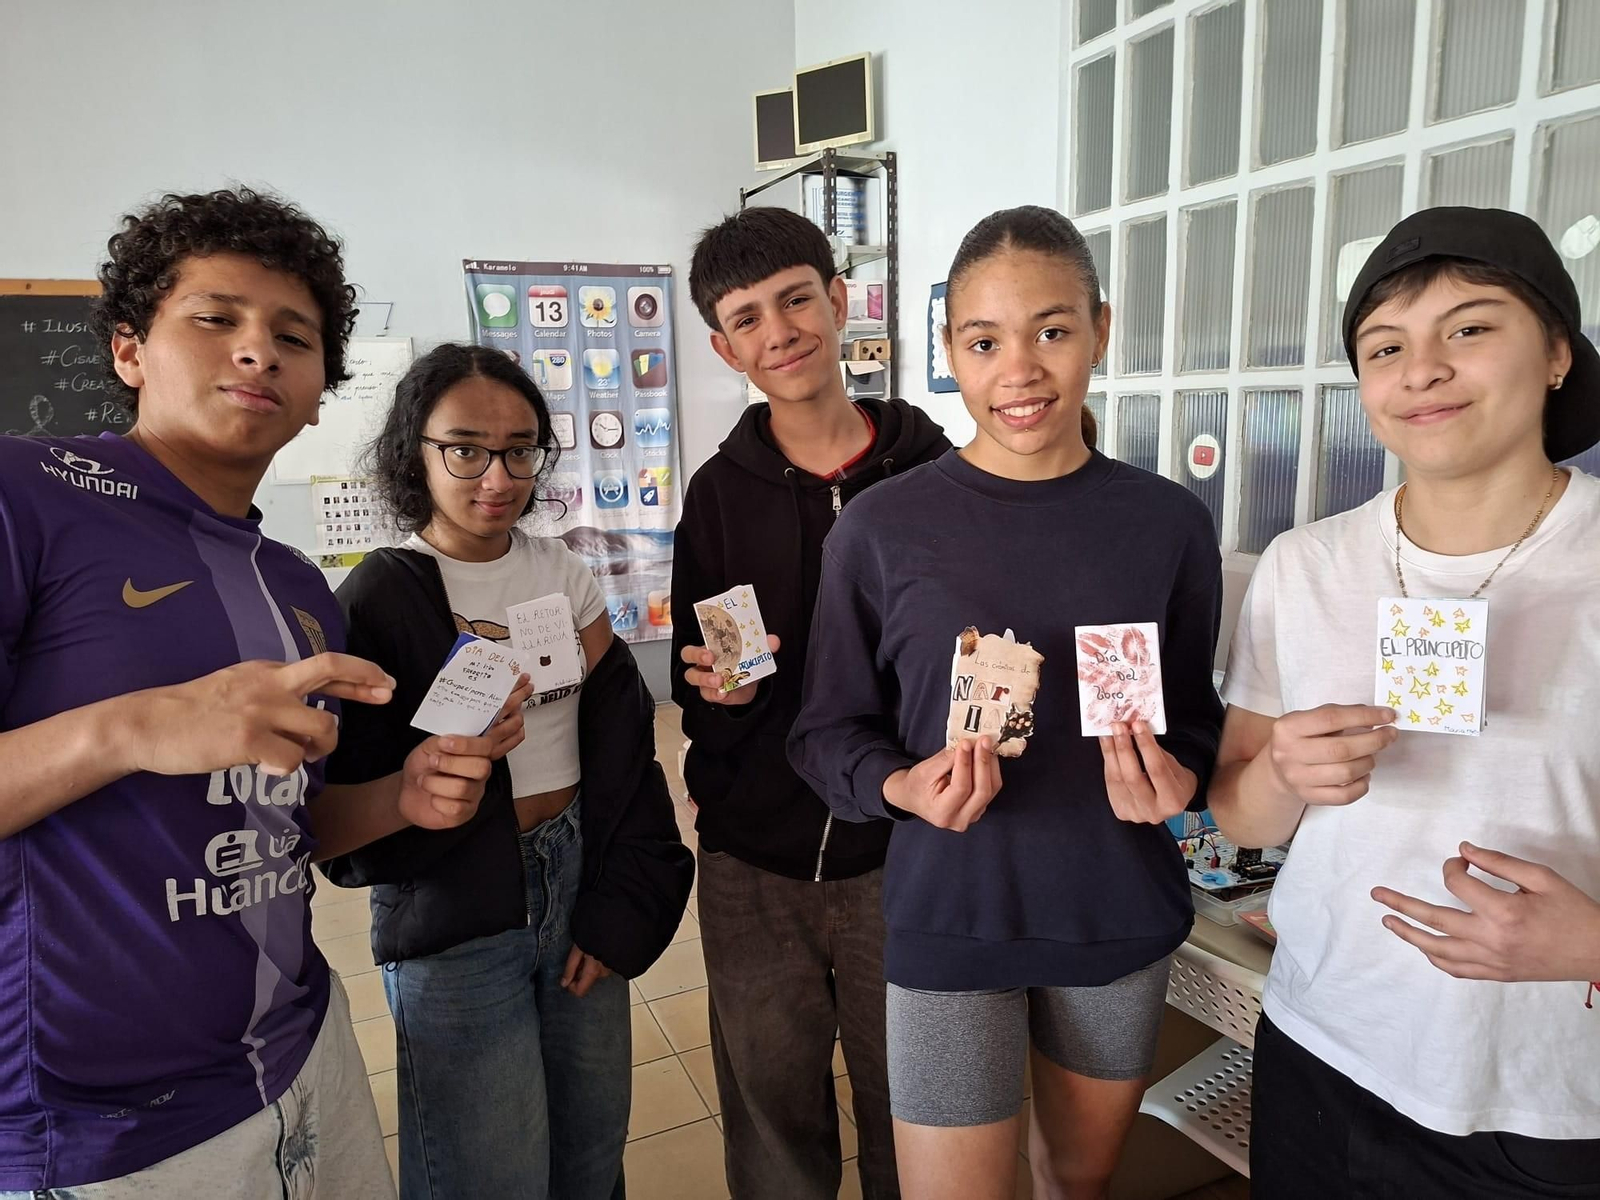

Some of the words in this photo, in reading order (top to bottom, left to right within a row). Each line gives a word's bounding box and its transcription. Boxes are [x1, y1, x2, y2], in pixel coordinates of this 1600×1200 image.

[535, 301, 563, 322] 13
[482, 329, 518, 338] Messages
[534, 329, 567, 338] Calendar
[587, 329, 613, 338] Photos
[634, 329, 661, 337] Camera
[551, 356, 565, 364] 280
[545, 392, 566, 401] Maps
[589, 390, 619, 398] Weather
[634, 389, 668, 398] Passbook
[644, 449, 667, 457] Stocks
[40, 461, 138, 500] HYUNDAI
[723, 597, 738, 610] EL
[1380, 636, 1402, 657] EL
[1406, 637, 1484, 660] PRINCIPITO
[488, 652, 505, 663] DEL
[738, 651, 772, 671] PRINCIPITO
[974, 651, 989, 668] Las
[1020, 663, 1031, 675] de
